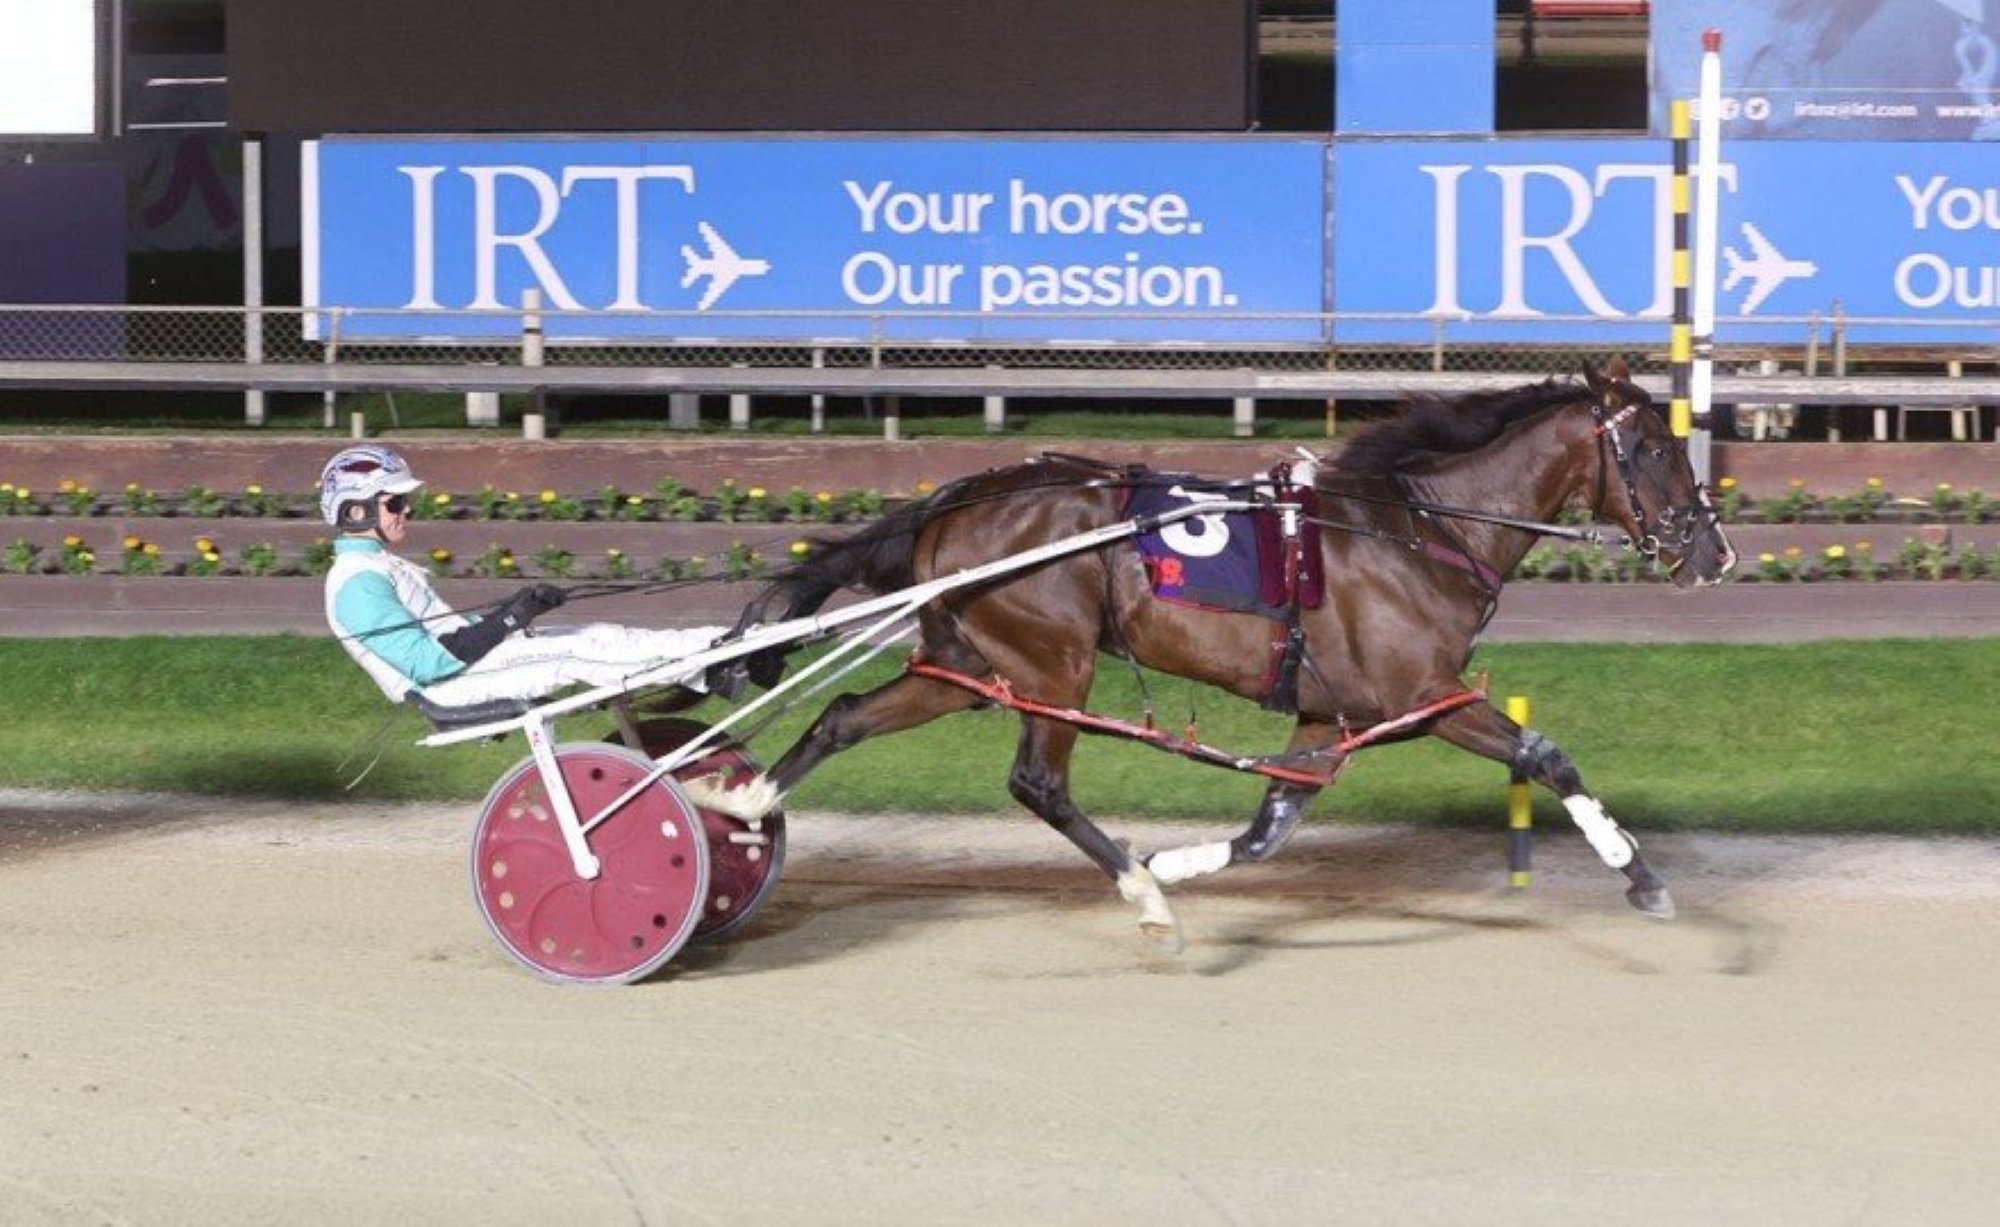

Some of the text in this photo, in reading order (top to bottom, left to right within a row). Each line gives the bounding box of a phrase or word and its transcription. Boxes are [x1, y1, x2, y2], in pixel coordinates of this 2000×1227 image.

[844, 179, 1203, 235] Your horse.
[398, 165, 694, 312] IRT
[1419, 163, 1738, 318] IRT
[842, 251, 1238, 312] Our passion.
[1894, 252, 2000, 308] Ou
